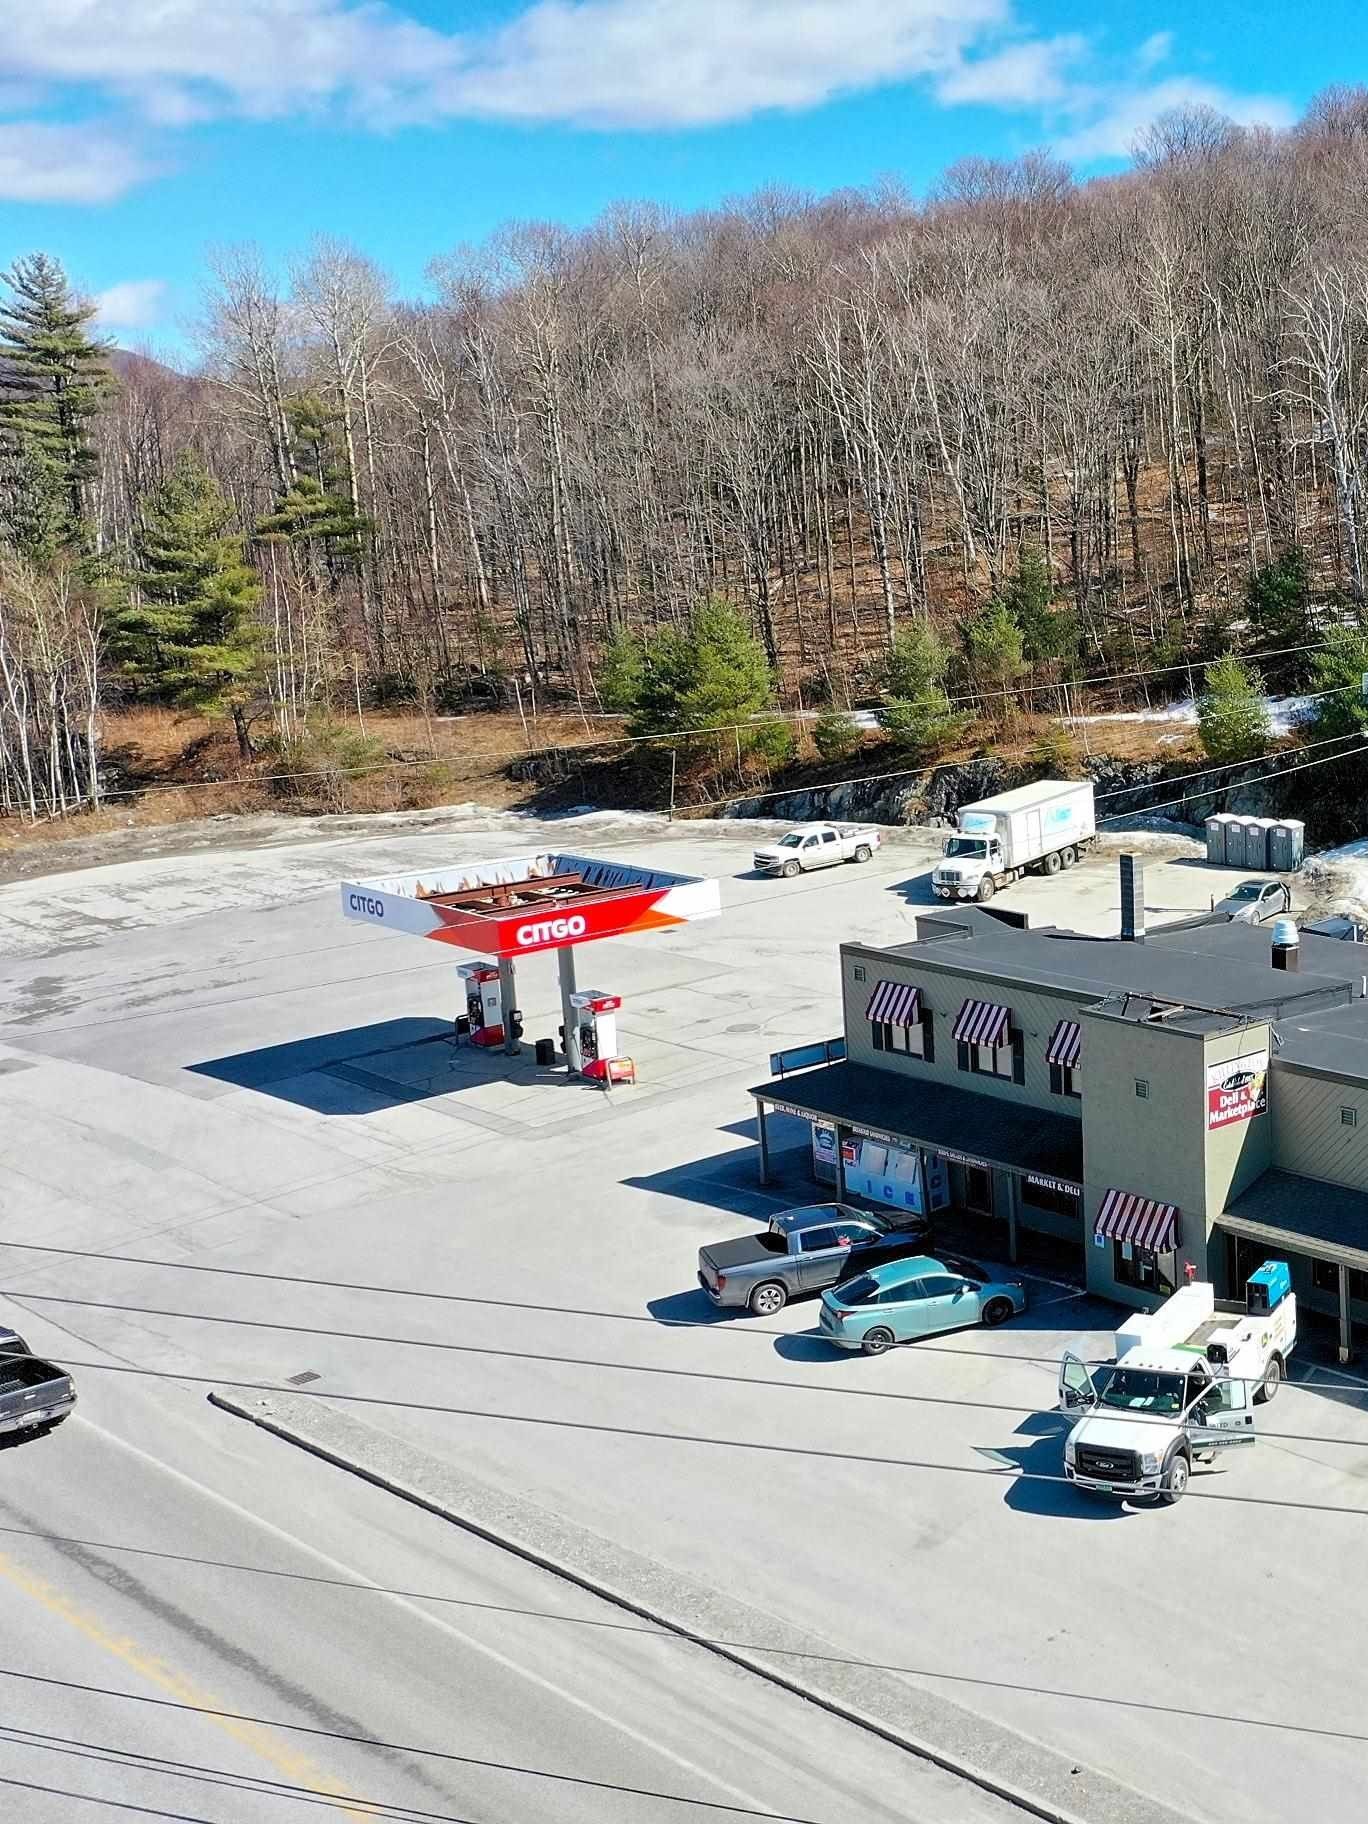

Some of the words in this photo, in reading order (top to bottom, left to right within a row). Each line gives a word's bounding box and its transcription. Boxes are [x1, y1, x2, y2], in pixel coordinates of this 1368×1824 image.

[350, 894, 384, 918] CITGO
[516, 915, 587, 946] CITGO
[1210, 1098, 1266, 1124] Marketplace
[1220, 1092, 1239, 1108] Deli
[1027, 1175, 1056, 1190] MARKET
[1065, 1185, 1080, 1197] DELI
